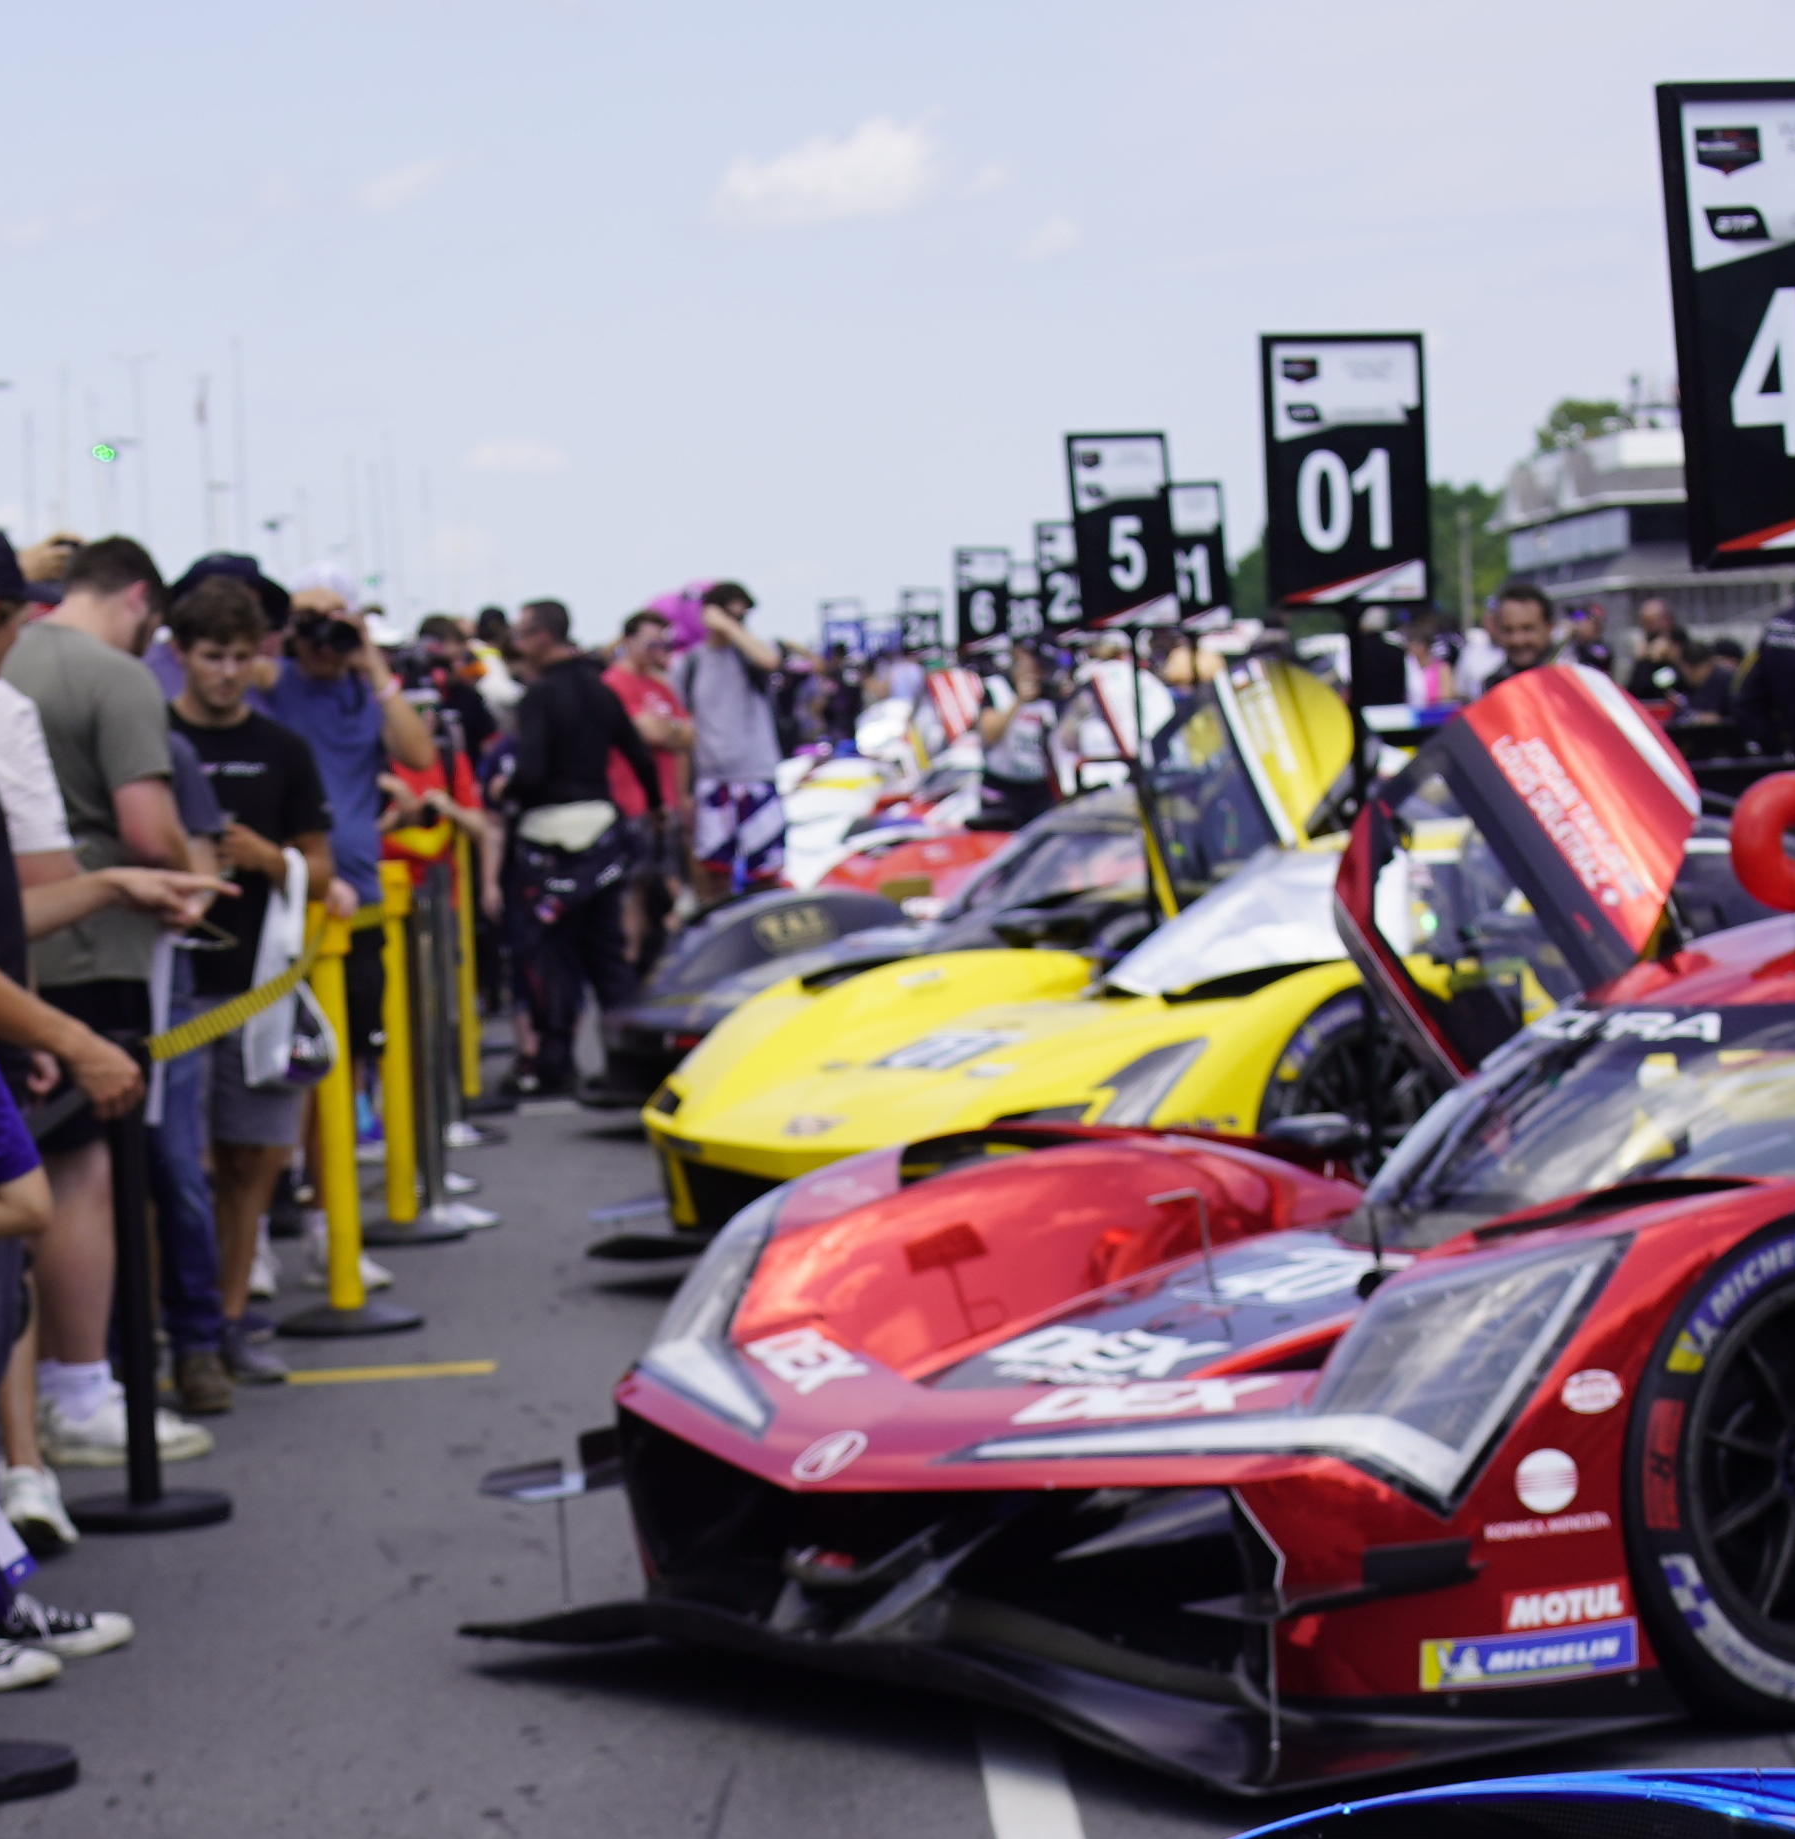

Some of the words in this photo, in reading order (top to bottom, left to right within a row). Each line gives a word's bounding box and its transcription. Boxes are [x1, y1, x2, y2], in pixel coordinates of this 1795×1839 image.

[1296, 447, 1394, 554] 01
[1108, 514, 1148, 593] 5
[968, 589, 997, 635] 6
[743, 1326, 870, 1395] DEX
[986, 1324, 1232, 1379] DEX
[1010, 1376, 1283, 1425] DEX
[1507, 1582, 1624, 1631] MOTUL
[1485, 1635, 1621, 1673] MICHELIN
